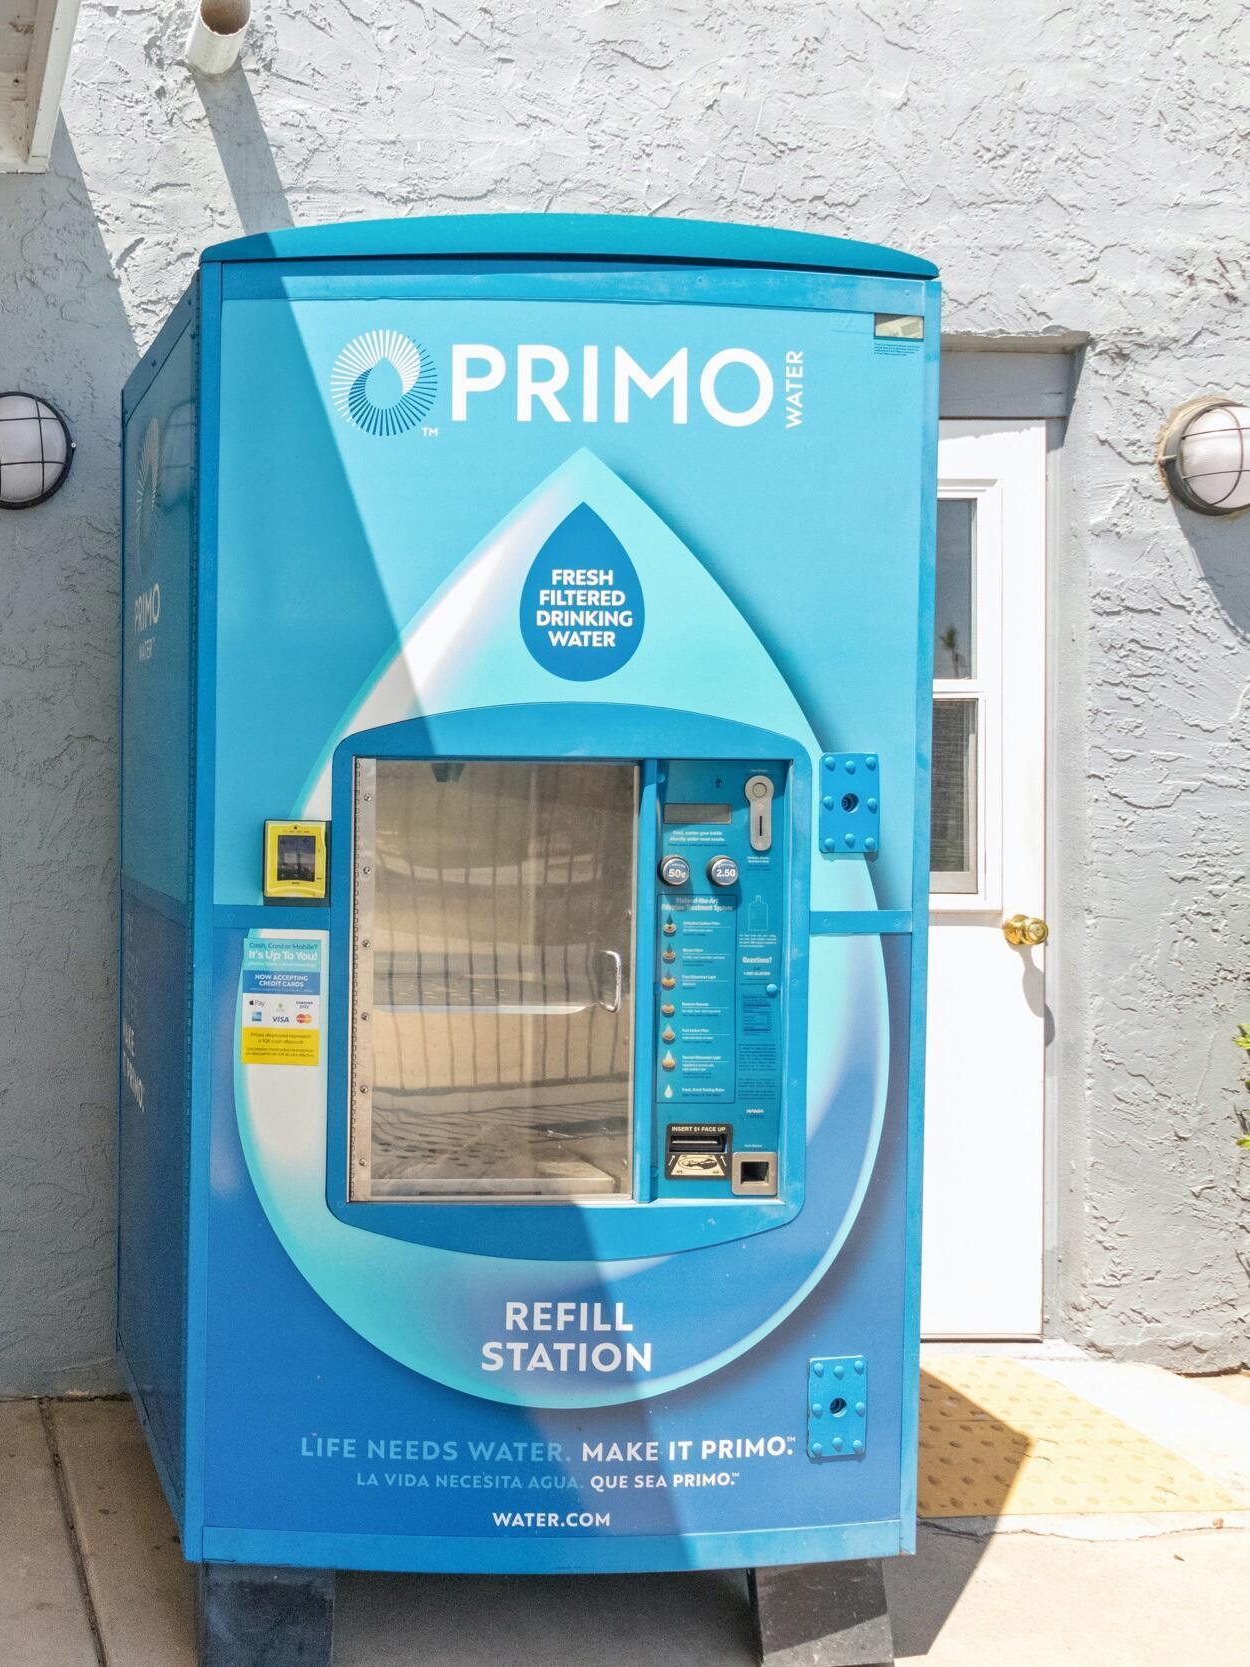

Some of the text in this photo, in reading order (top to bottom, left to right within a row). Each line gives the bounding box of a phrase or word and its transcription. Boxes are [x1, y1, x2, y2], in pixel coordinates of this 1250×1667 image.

[452, 344, 773, 427] PRIMO
[786, 351, 803, 429] WATER
[551, 569, 614, 586] FRESH
[539, 589, 626, 606] FILTERED
[135, 583, 160, 635] PRIMO
[536, 610, 633, 627] DRINKING
[548, 631, 616, 647] WATER
[716, 868, 736, 878] 2.50
[265, 951, 281, 962] Up
[282, 951, 295, 960] To
[295, 952, 318, 961] You!
[273, 974, 309, 982] ACCEPTING
[506, 1301, 634, 1331] REFILL
[481, 1341, 652, 1372] STATION
[301, 1437, 356, 1458] LIFE
[368, 1440, 458, 1461] NEEDS
[468, 1442, 571, 1462] WATER.
[582, 1442, 659, 1462] MAKE
[669, 1441, 693, 1460] IT
[357, 1472, 379, 1486] LA
[385, 1473, 429, 1488] VIDA
[436, 1475, 523, 1489] NECESITA
[528, 1475, 584, 1489] AGUA.
[590, 1475, 628, 1492] QUE
[634, 1474, 667, 1488] SEA
[493, 1512, 610, 1527] WATER.COM
